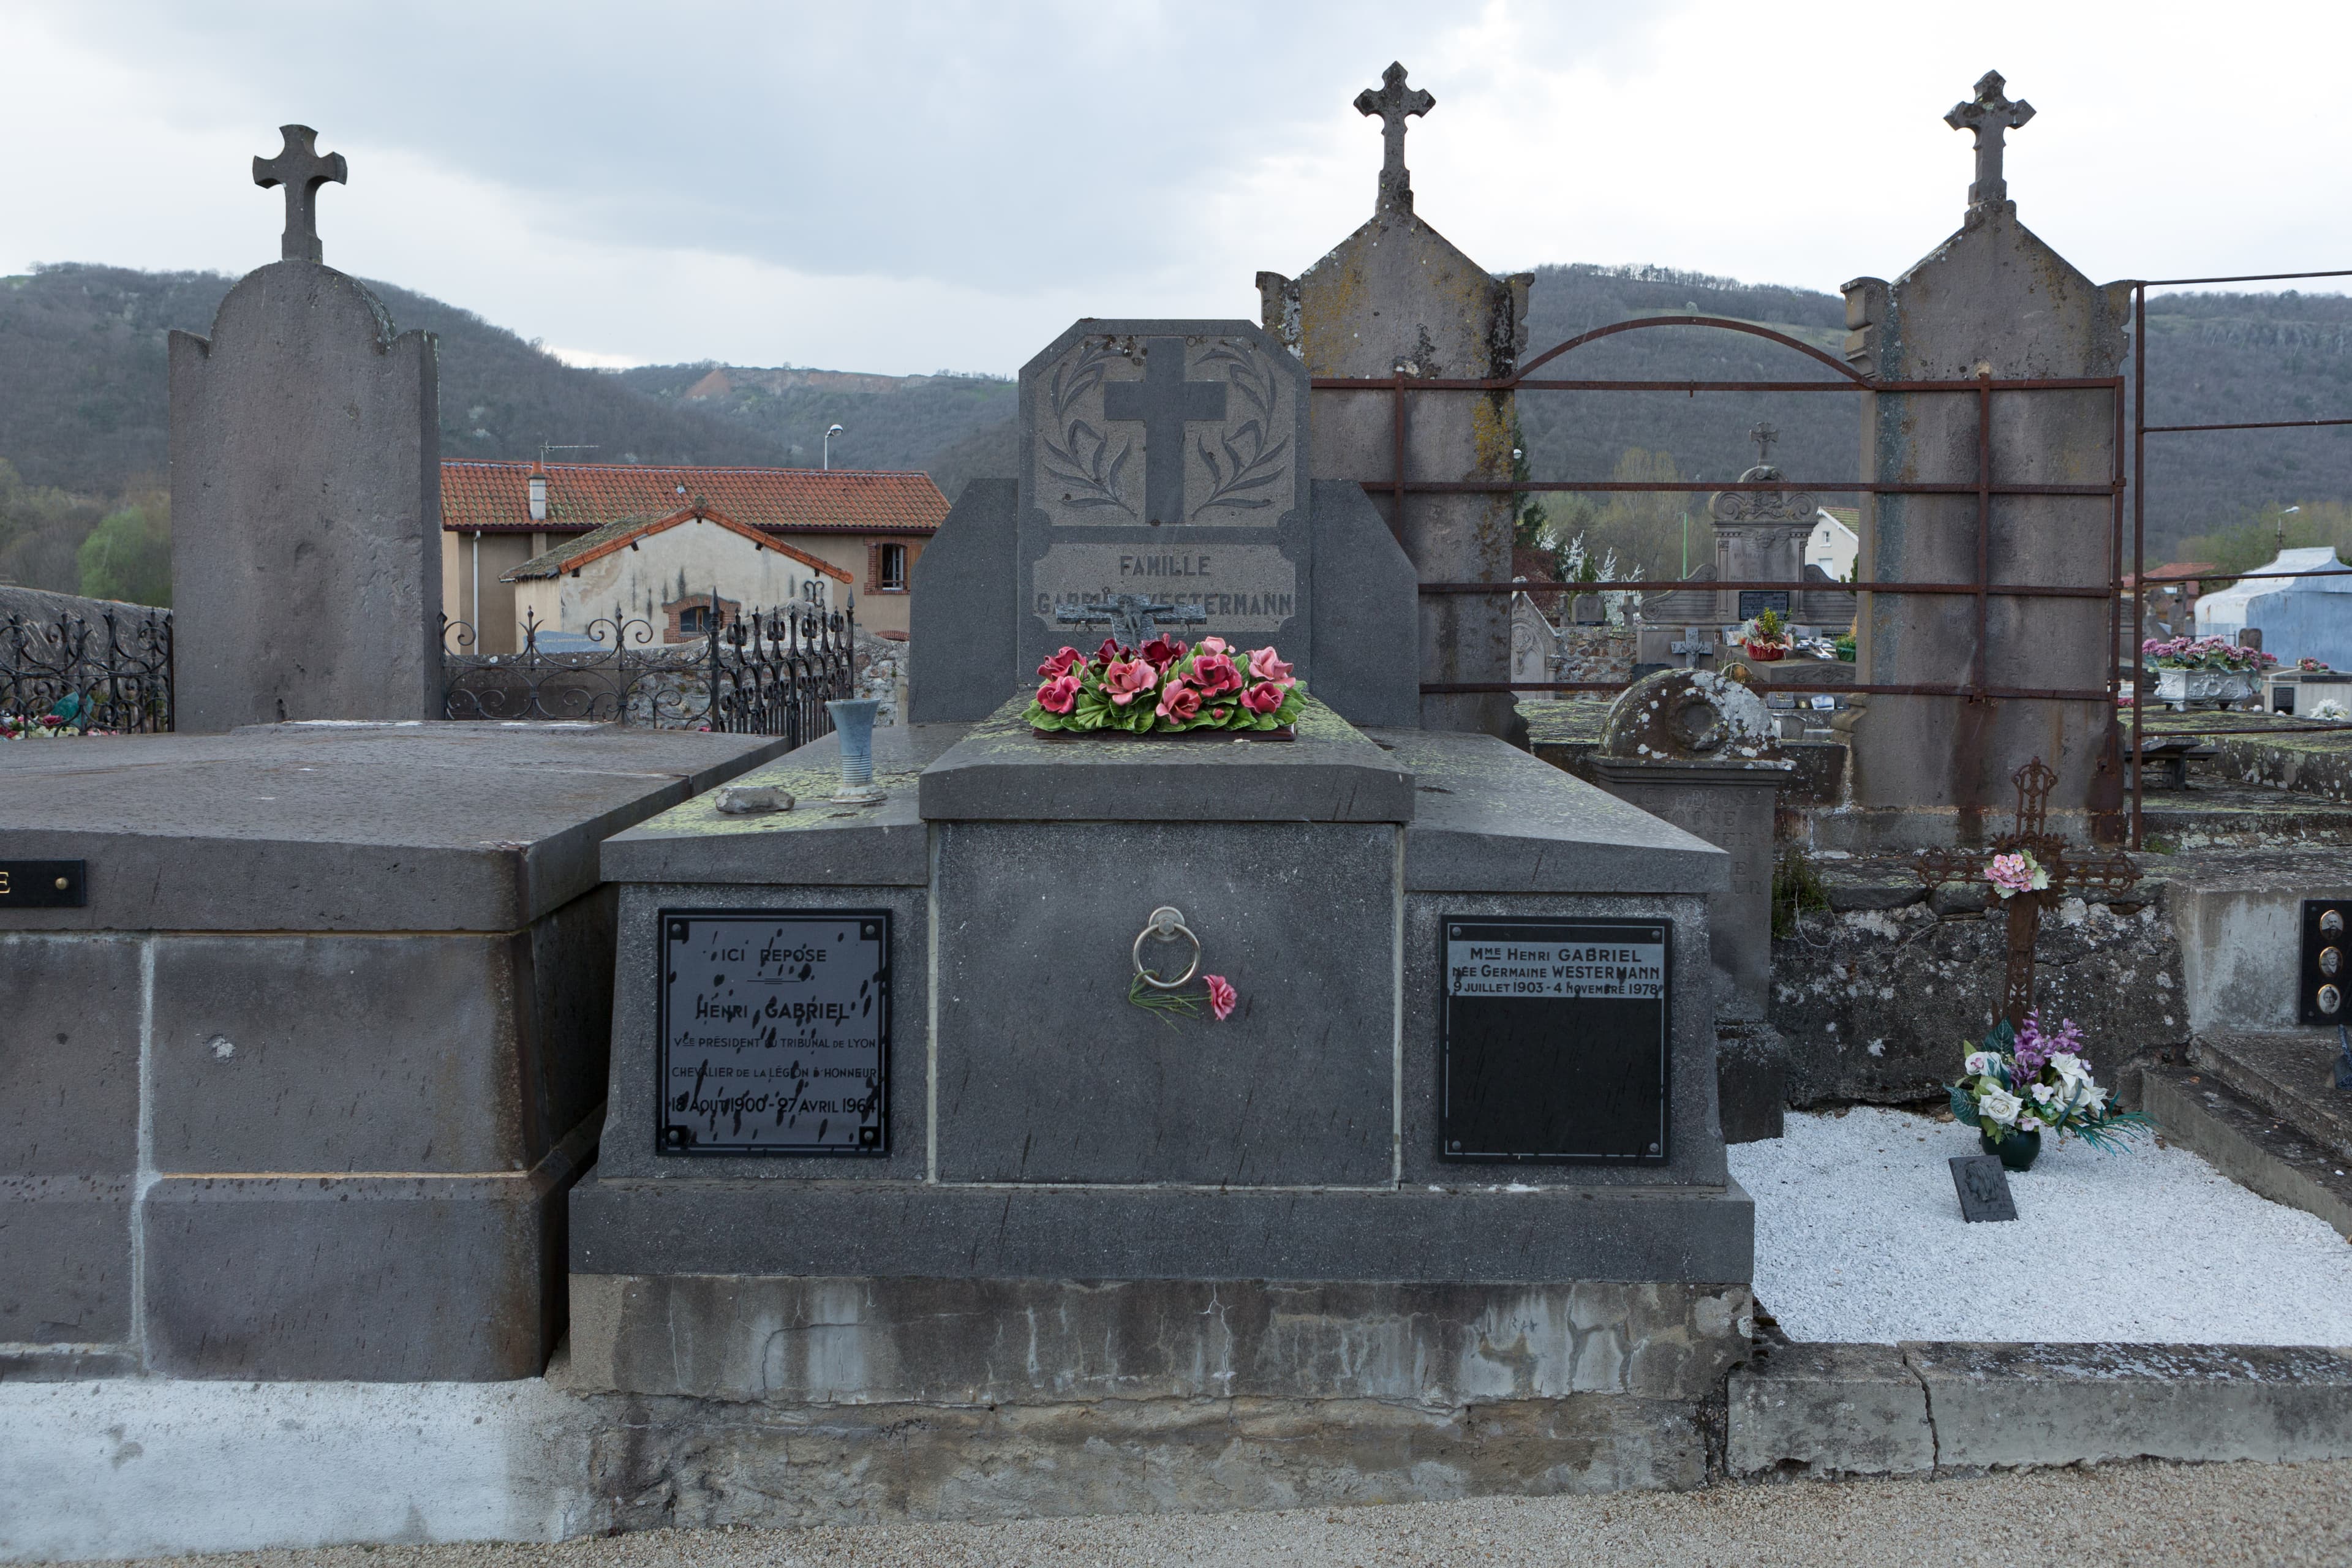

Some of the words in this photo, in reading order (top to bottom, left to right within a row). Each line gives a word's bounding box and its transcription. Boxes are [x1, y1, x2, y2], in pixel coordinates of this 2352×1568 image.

[1120, 556, 1211, 576] FAMILLE
[722, 949, 744, 961] ICI
[760, 949, 826, 962] REPOSE
[1558, 948, 1642, 962] GABRIEL
[1552, 965, 1659, 979] WESTERMANN
[1453, 981, 1462, 992] 9
[1464, 984, 1510, 992] JUILLET
[1513, 982, 1544, 993] 1903
[1553, 983, 1562, 993] 4
[1629, 984, 1658, 995] 1978
[765, 1003, 850, 1019] GABRIEL
[699, 1036, 760, 1047] PRÉSIDENT
[780, 1038, 830, 1048] TRIBUNAL
[848, 1038, 876, 1048] LYON
[672, 1068, 733, 1077] CHEVALIER
[731, 1098, 766, 1112] 1900
[777, 1098, 796, 1112] 27
[843, 1098, 876, 1113] 1964
